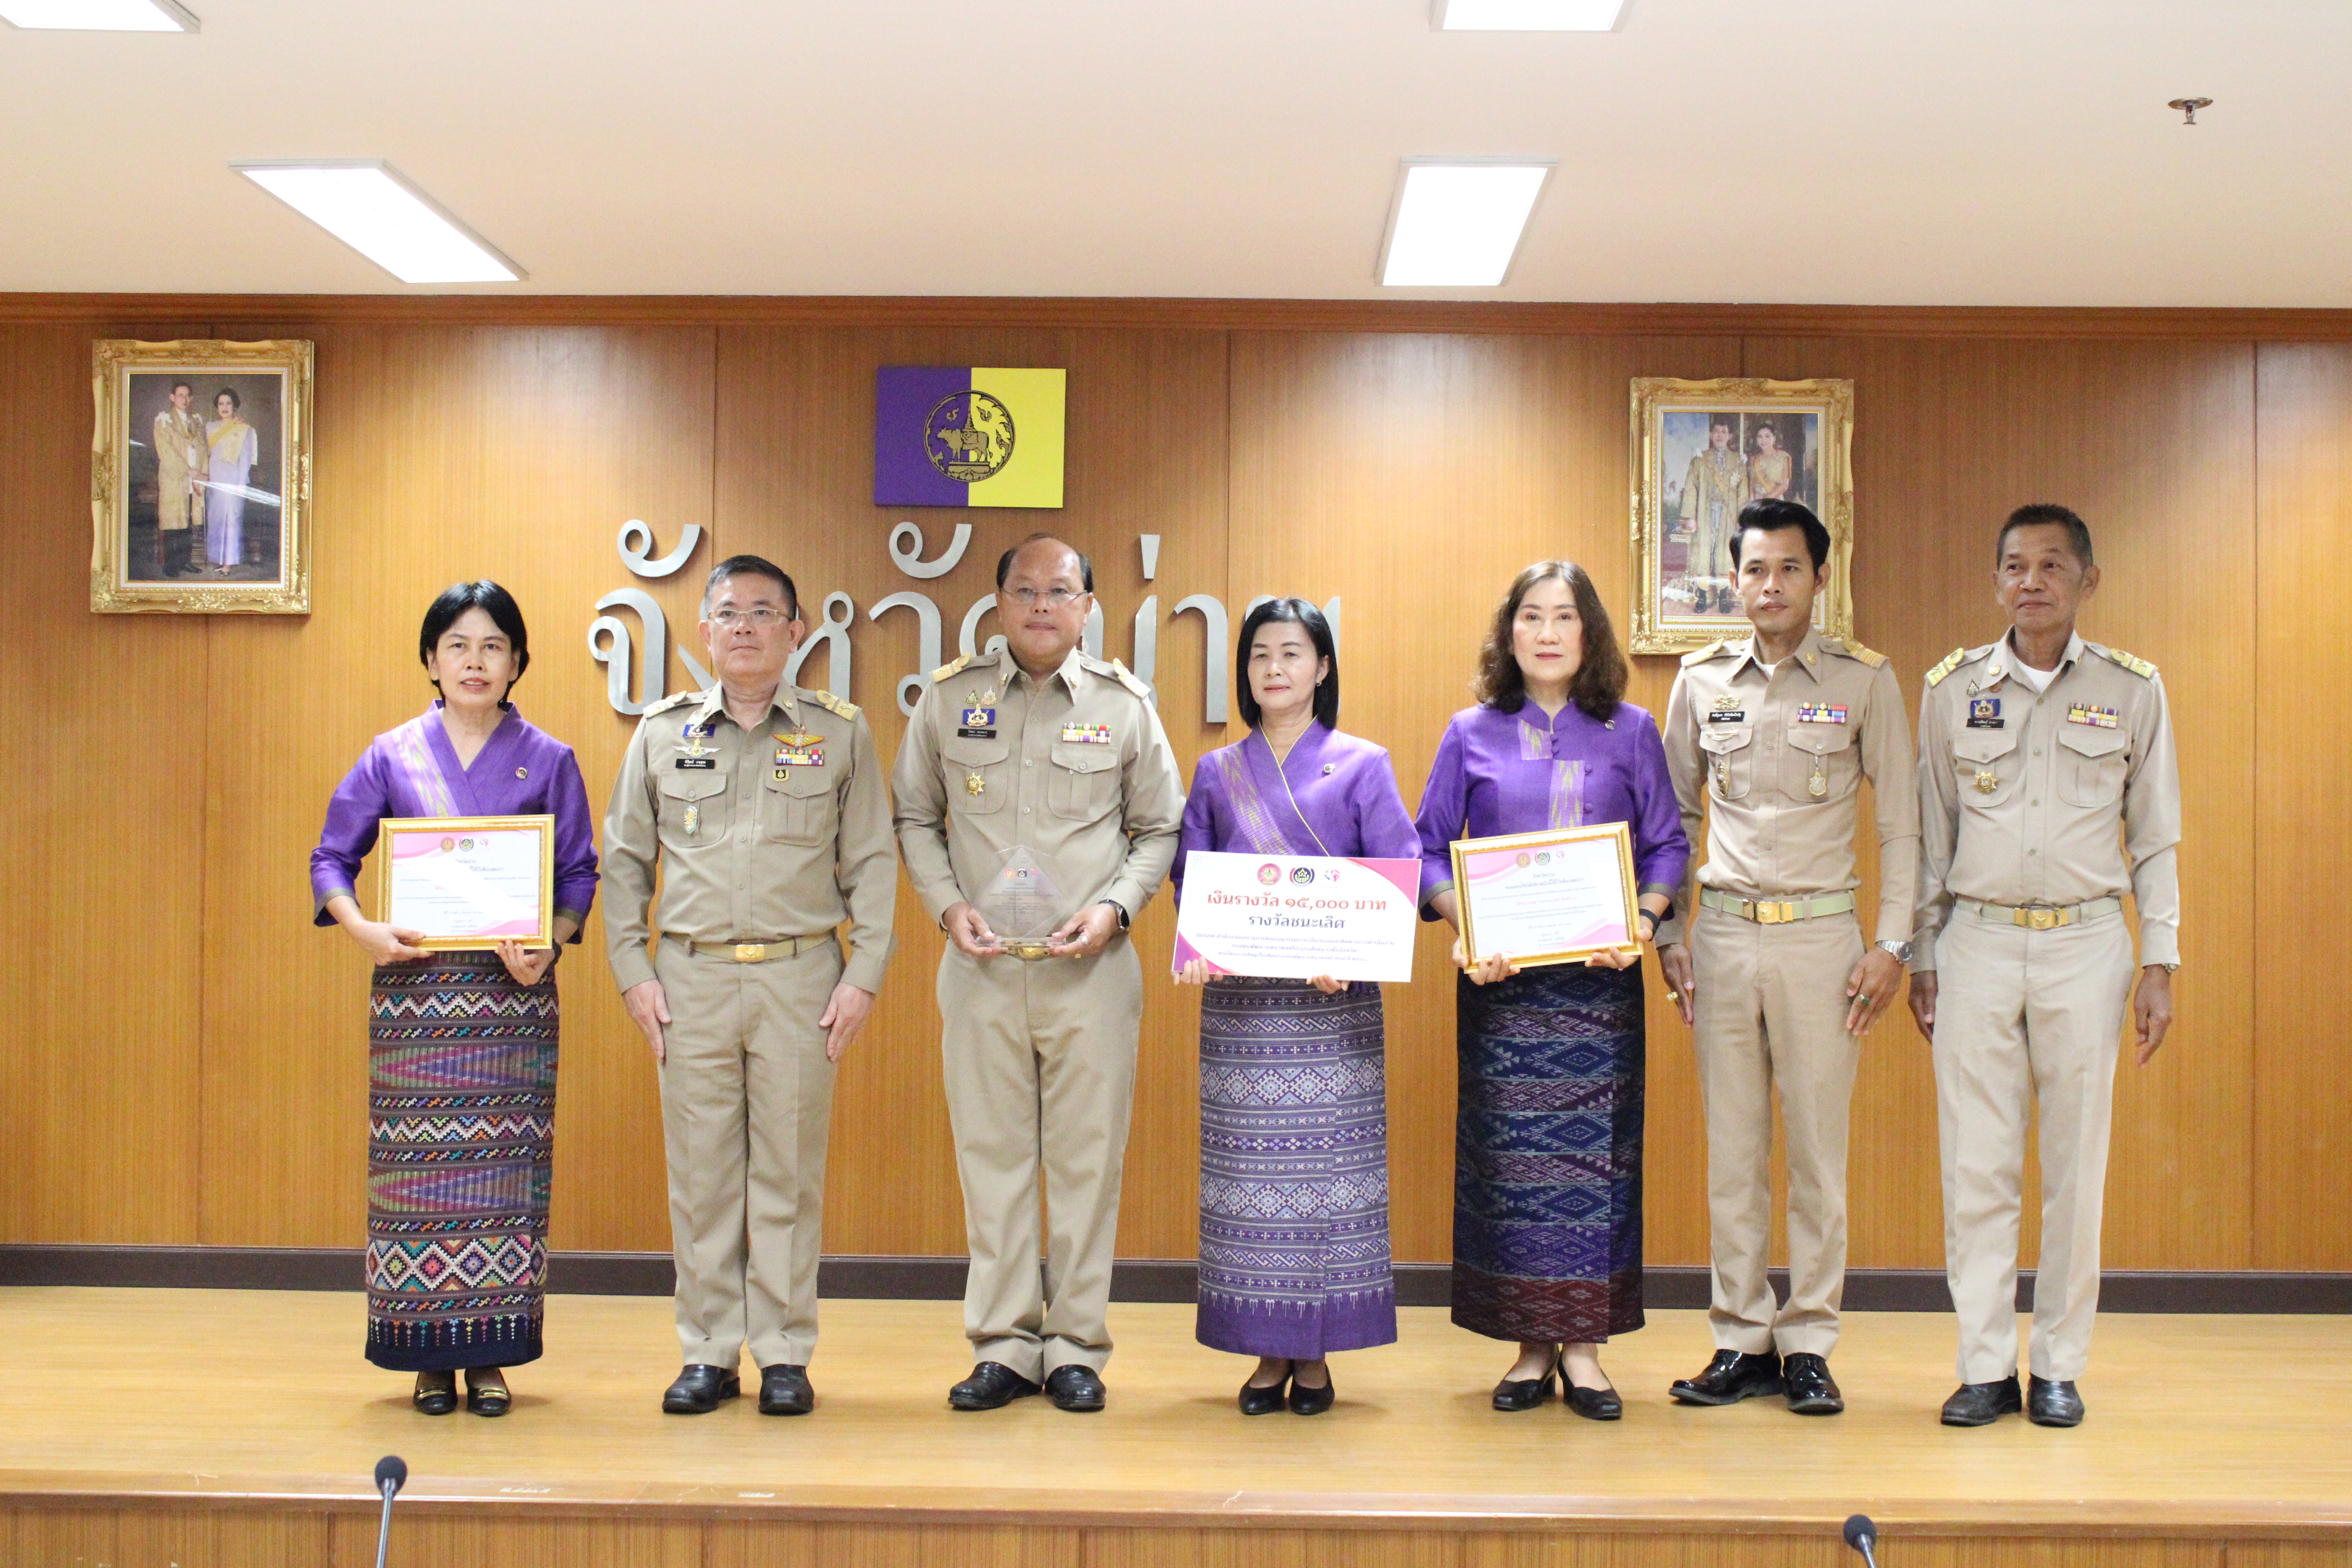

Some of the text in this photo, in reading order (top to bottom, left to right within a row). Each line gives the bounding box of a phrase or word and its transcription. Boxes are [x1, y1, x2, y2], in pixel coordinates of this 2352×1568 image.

[1207, 890, 1387, 910] เงินรางวัล ๑๕,๐๐๐ บาท
[1249, 912, 1346, 929] รางวัลชนะเลิศ
